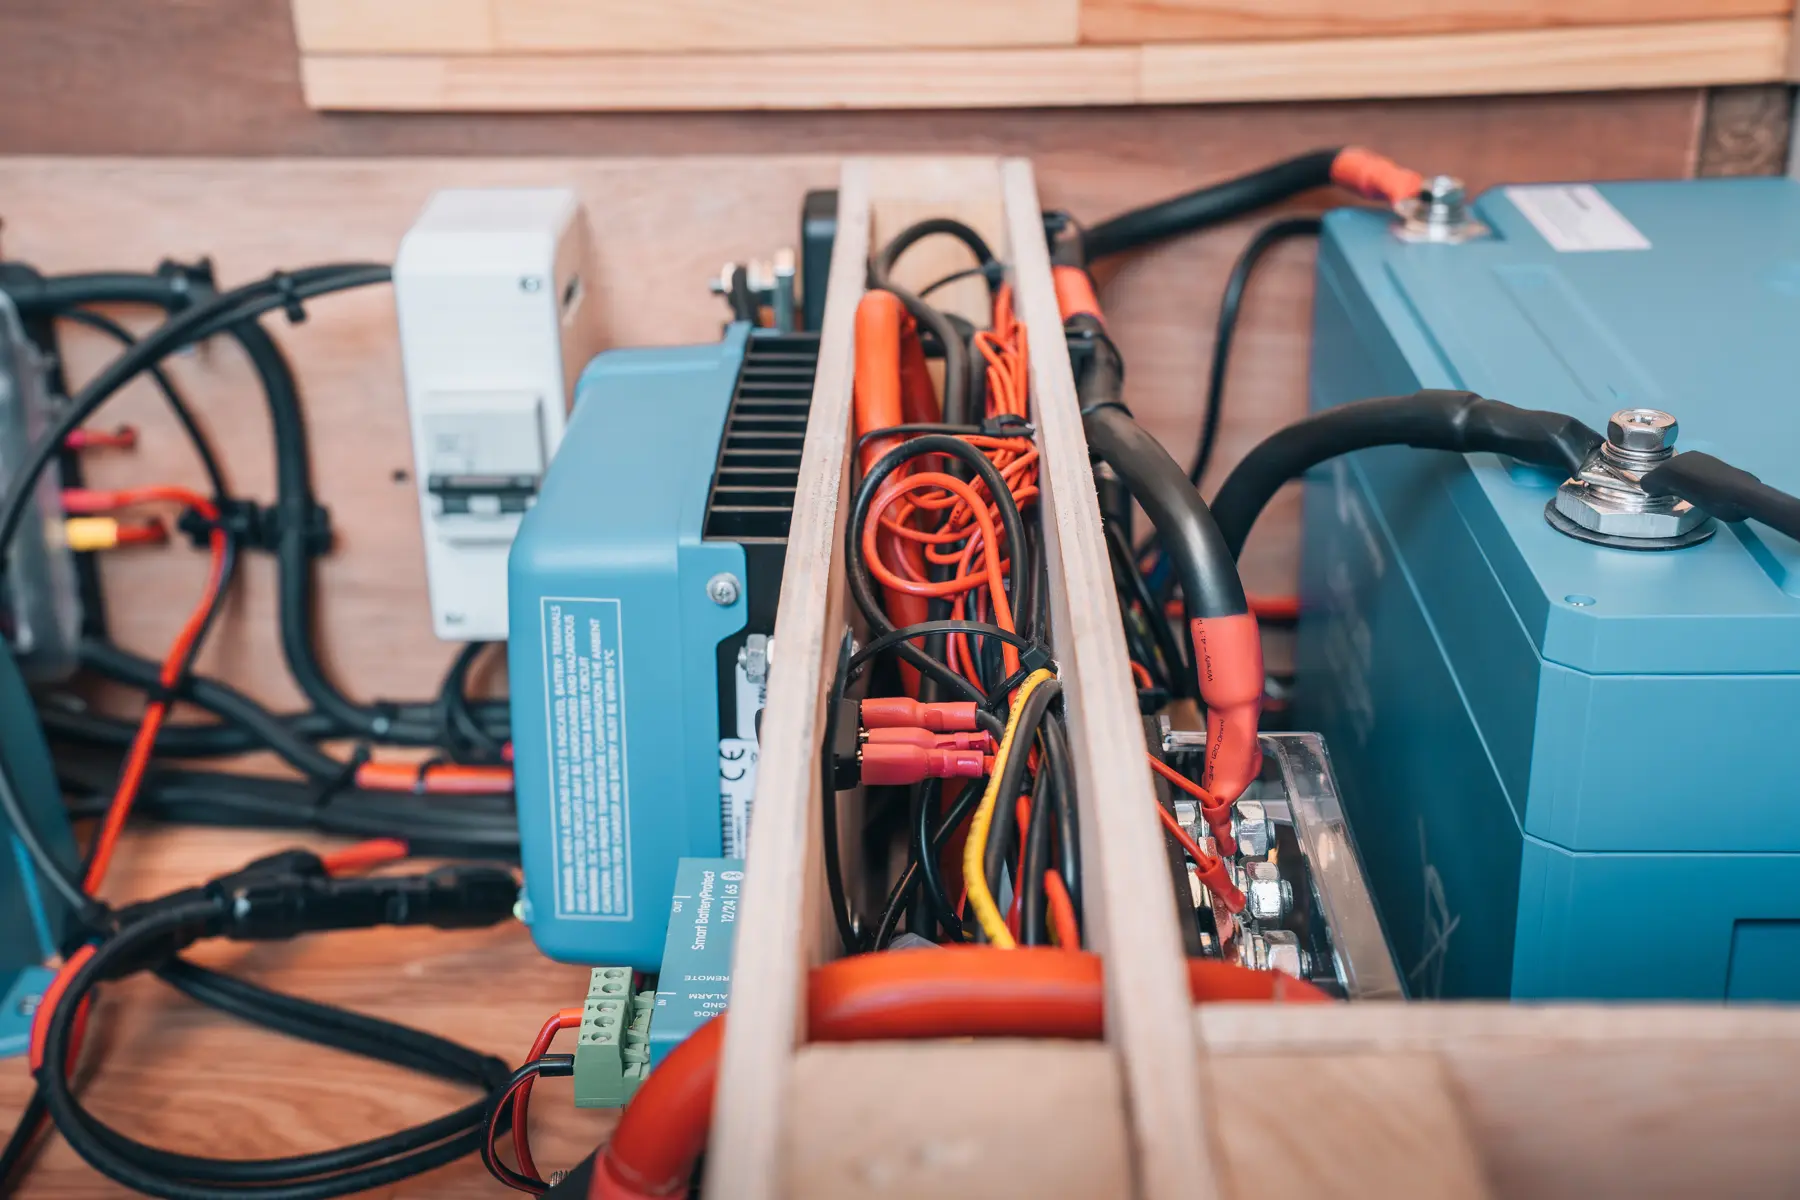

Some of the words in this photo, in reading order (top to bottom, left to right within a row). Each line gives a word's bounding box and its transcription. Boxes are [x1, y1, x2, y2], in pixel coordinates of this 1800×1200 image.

[551, 605, 562, 655] TERMINALS
[590, 617, 601, 659] AMBIENT
[564, 614, 576, 673] HAZARDOUS
[592, 661, 602, 678] THE
[604, 648, 614, 667] 5°C
[553, 656, 564, 695] BATTERY
[567, 674, 577, 695] AND
[578, 656, 590, 692] CIRCUIT
[694, 871, 715, 924] BatteryProtect
[726, 884, 738, 894] 65
[674, 901, 683, 912] OUT
[721, 900, 737, 923] 12/24
[691, 925, 708, 950] Smart
